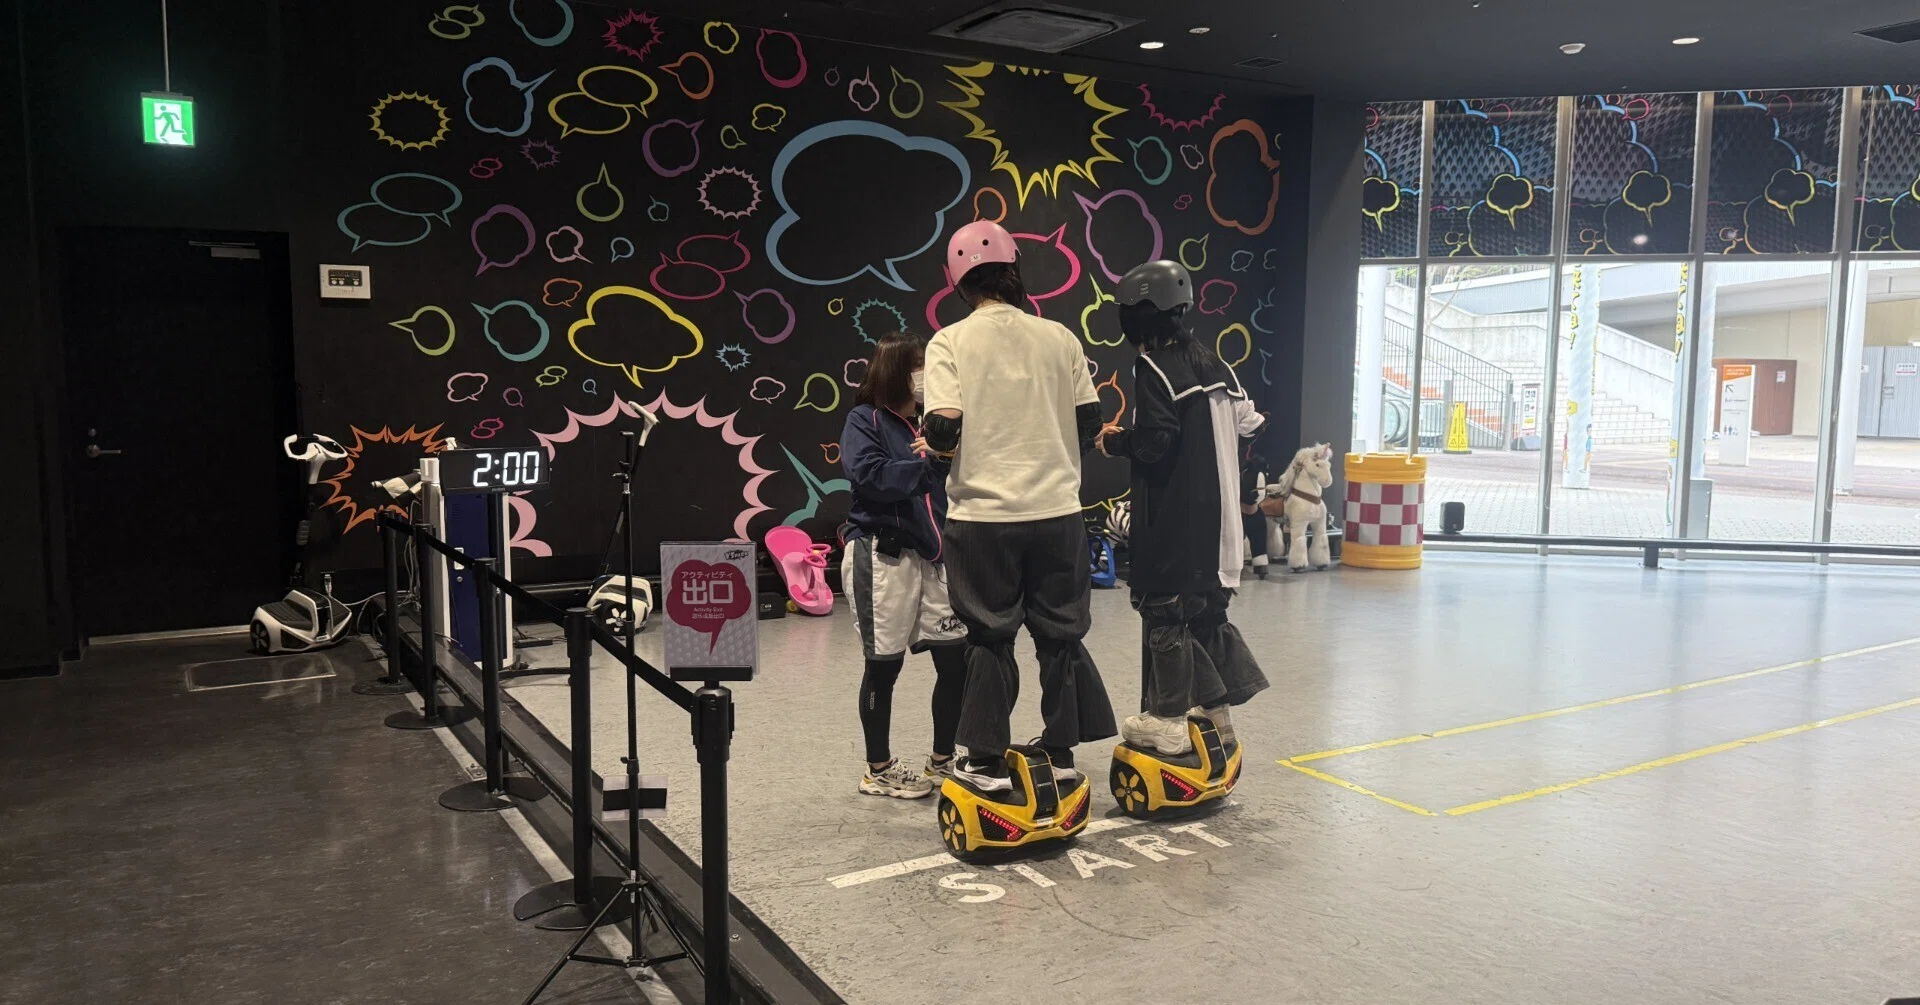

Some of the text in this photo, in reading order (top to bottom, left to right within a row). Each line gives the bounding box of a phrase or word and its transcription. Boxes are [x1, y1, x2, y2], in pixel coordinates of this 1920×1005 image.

[473, 451, 540, 487] 2:00
[681, 571, 733, 579] アクティビティ
[682, 579, 734, 604] 出口
[938, 822, 1233, 903] START
